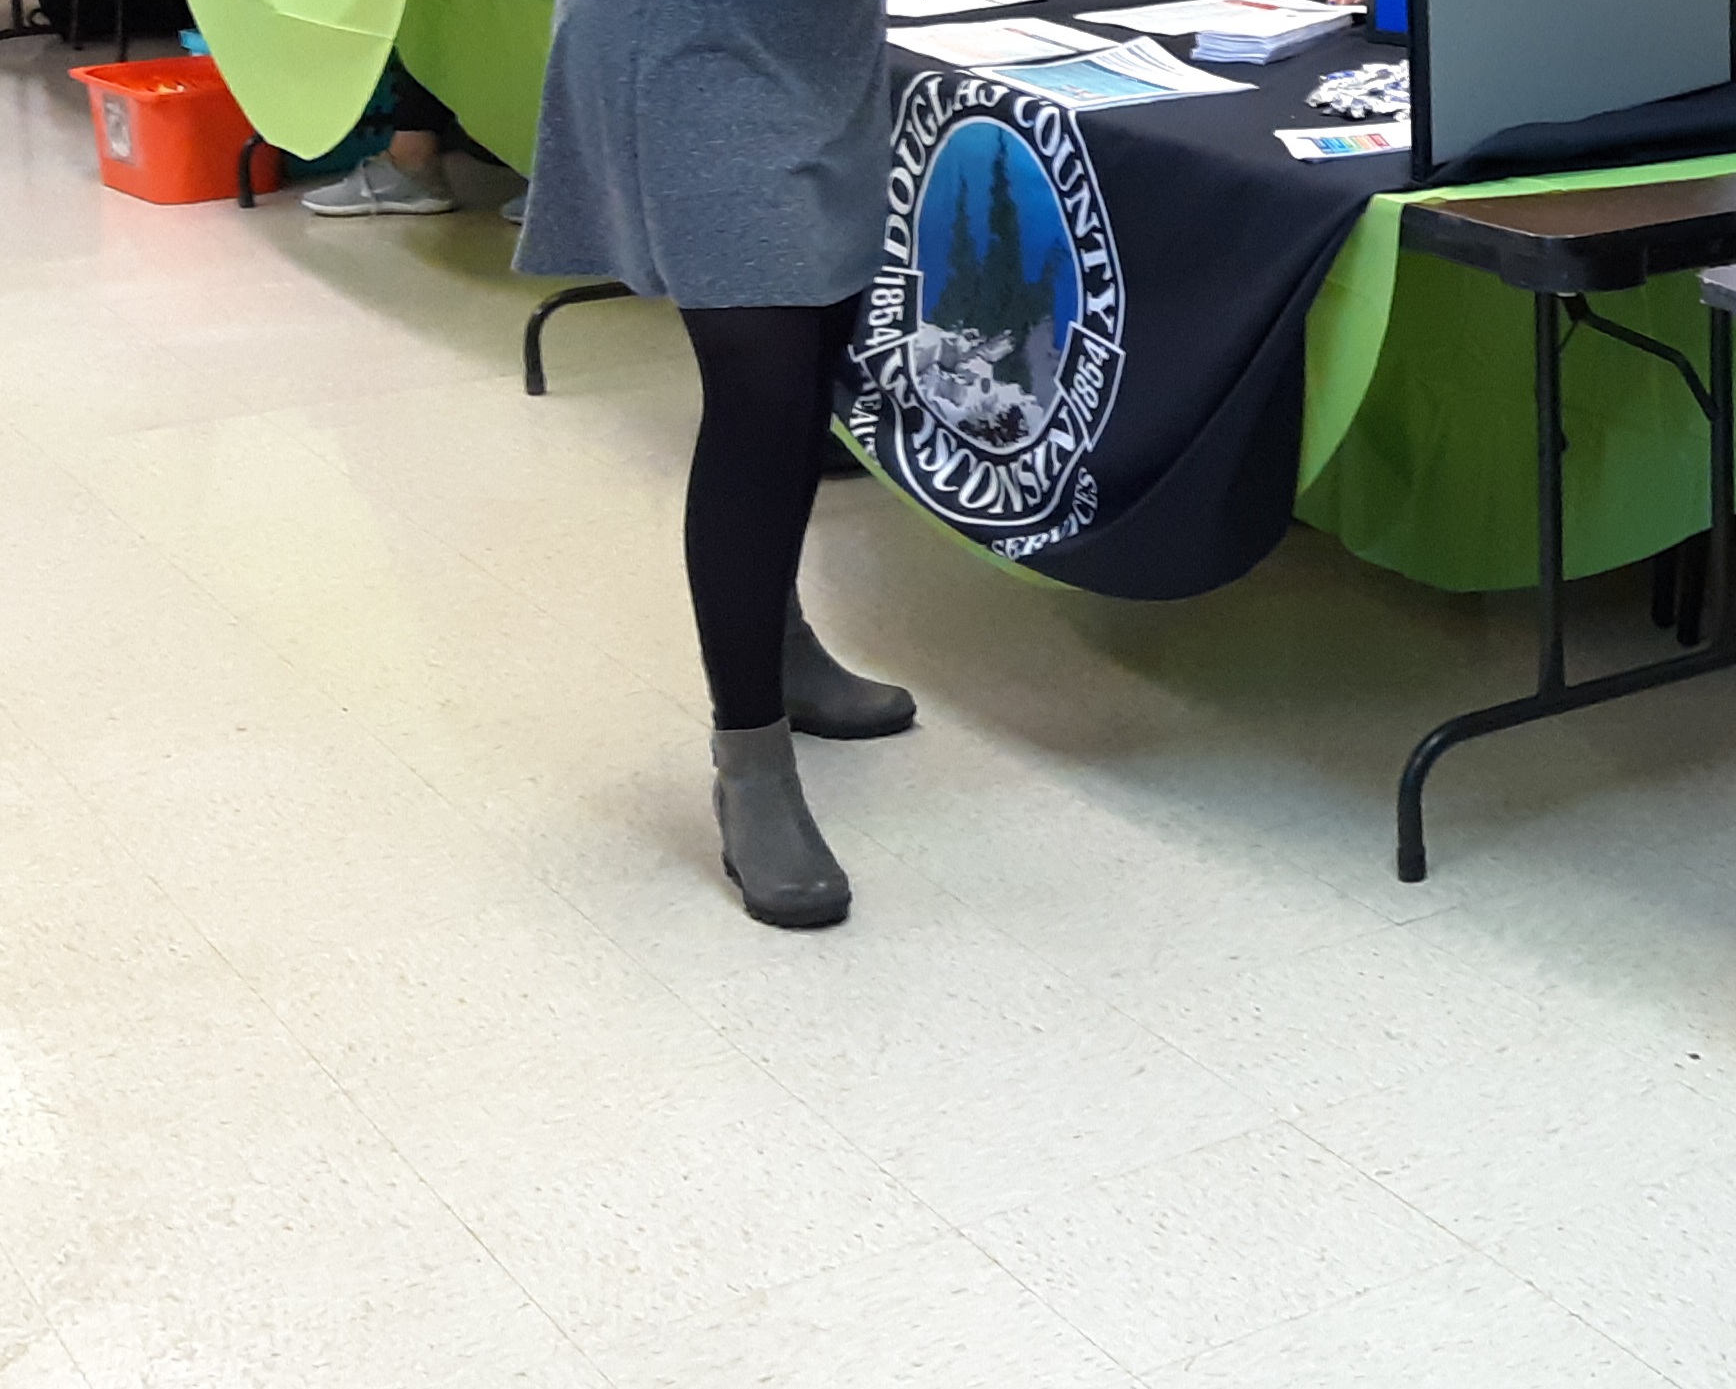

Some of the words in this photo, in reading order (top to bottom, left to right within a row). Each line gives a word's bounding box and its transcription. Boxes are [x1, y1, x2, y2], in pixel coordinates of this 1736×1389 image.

[1013, 95, 1117, 335] COUNTY
[864, 275, 907, 347] 1854
[1070, 337, 1111, 423] 1854
[991, 466, 1099, 561] SERVICES
